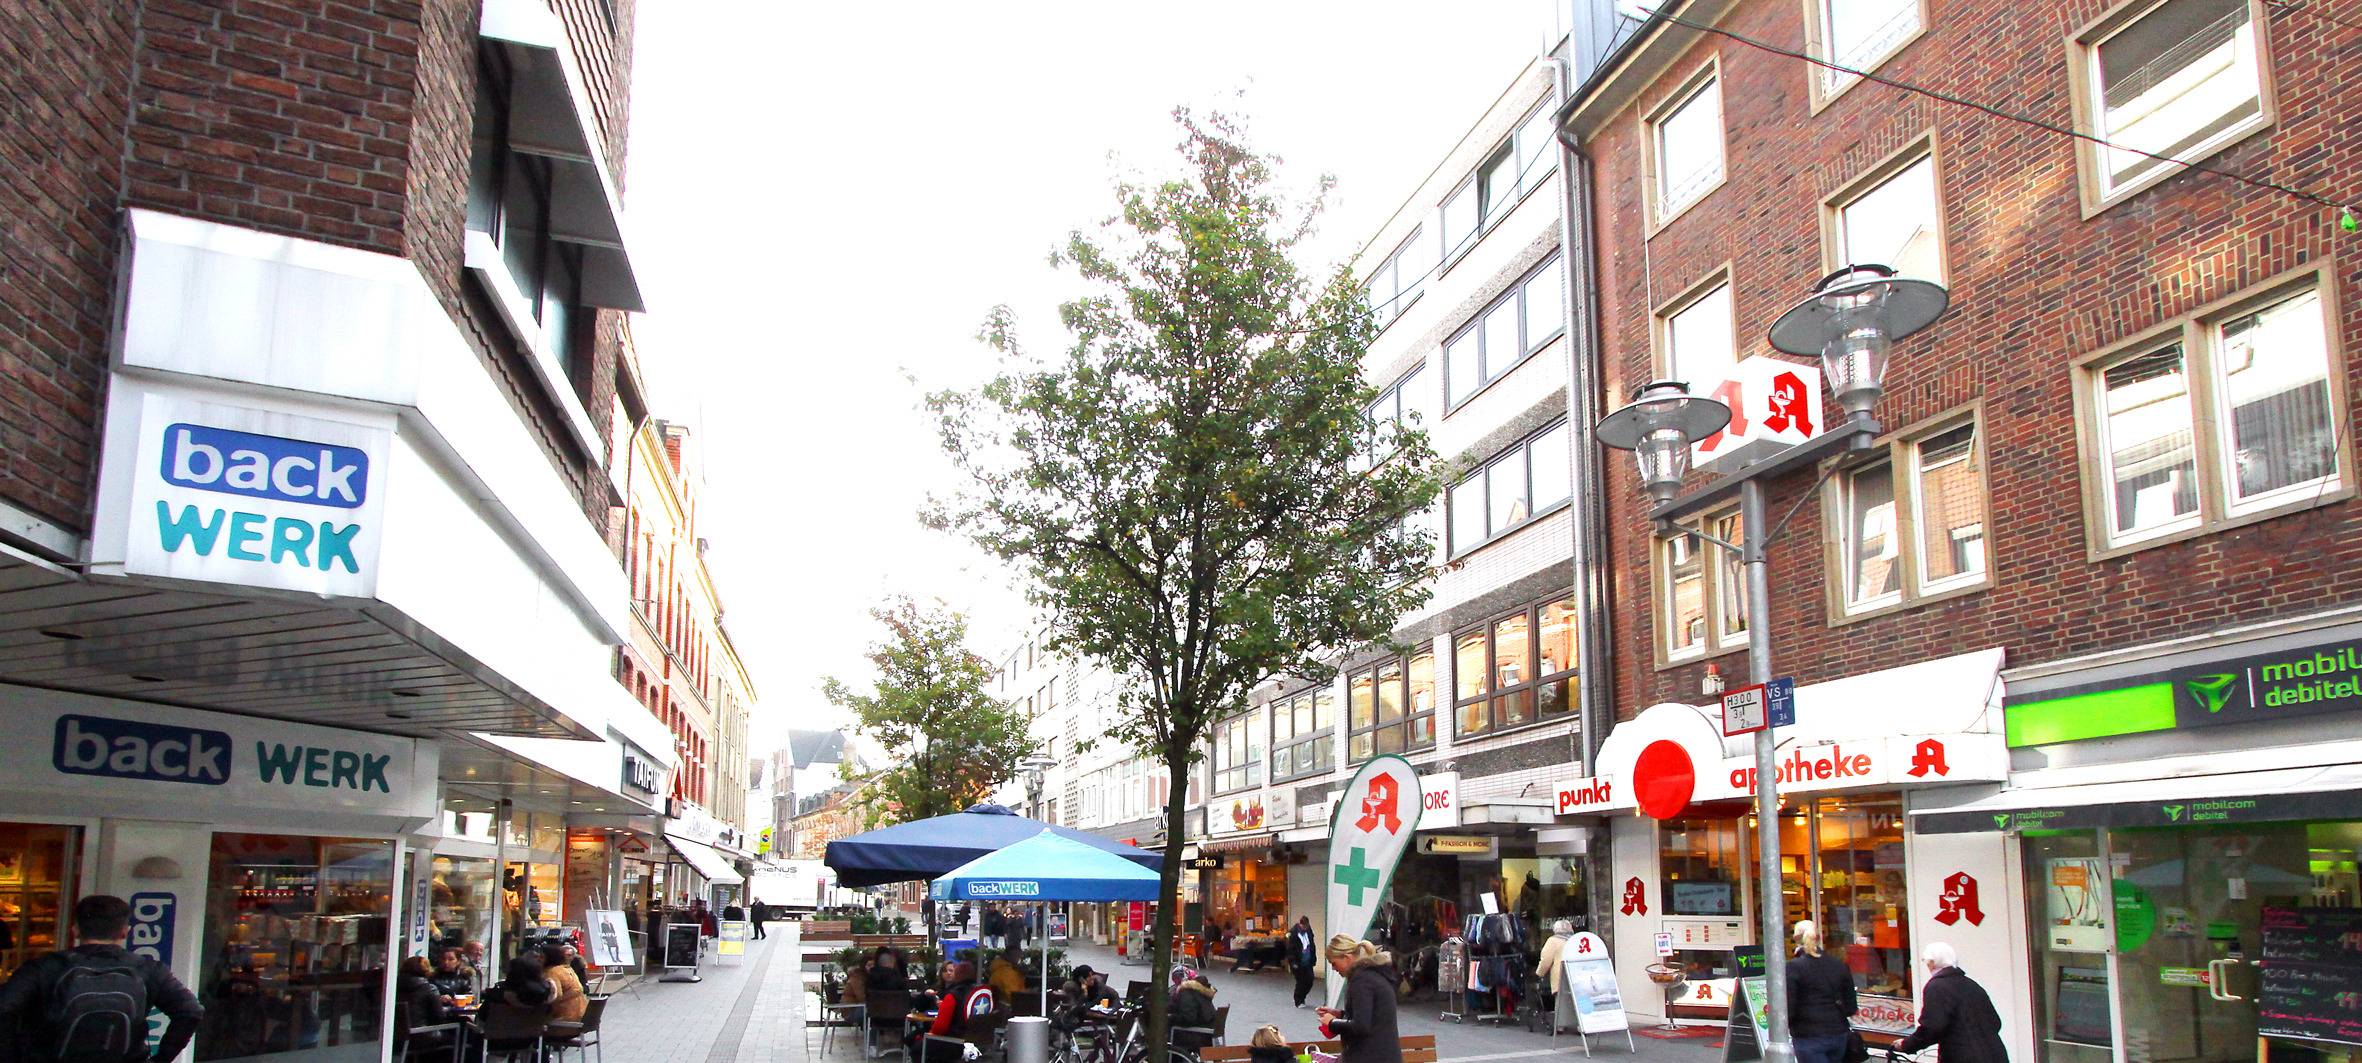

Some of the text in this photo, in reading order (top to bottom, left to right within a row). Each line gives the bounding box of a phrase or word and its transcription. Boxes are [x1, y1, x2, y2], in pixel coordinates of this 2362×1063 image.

[172, 428, 358, 503] back
[156, 500, 361, 574] WERK
[1726, 692, 1752, 707] H300
[1766, 686, 1781, 700] VS
[2265, 674, 2362, 708] debitel
[62, 718, 390, 794] back WERK
[1423, 789, 1450, 811] ORE
[1559, 777, 1612, 814] punkt
[2193, 798, 2256, 811] mobilcom
[1154, 805, 1169, 831] ark
[2193, 809, 2229, 820] debitel
[1195, 856, 1217, 868] arko
